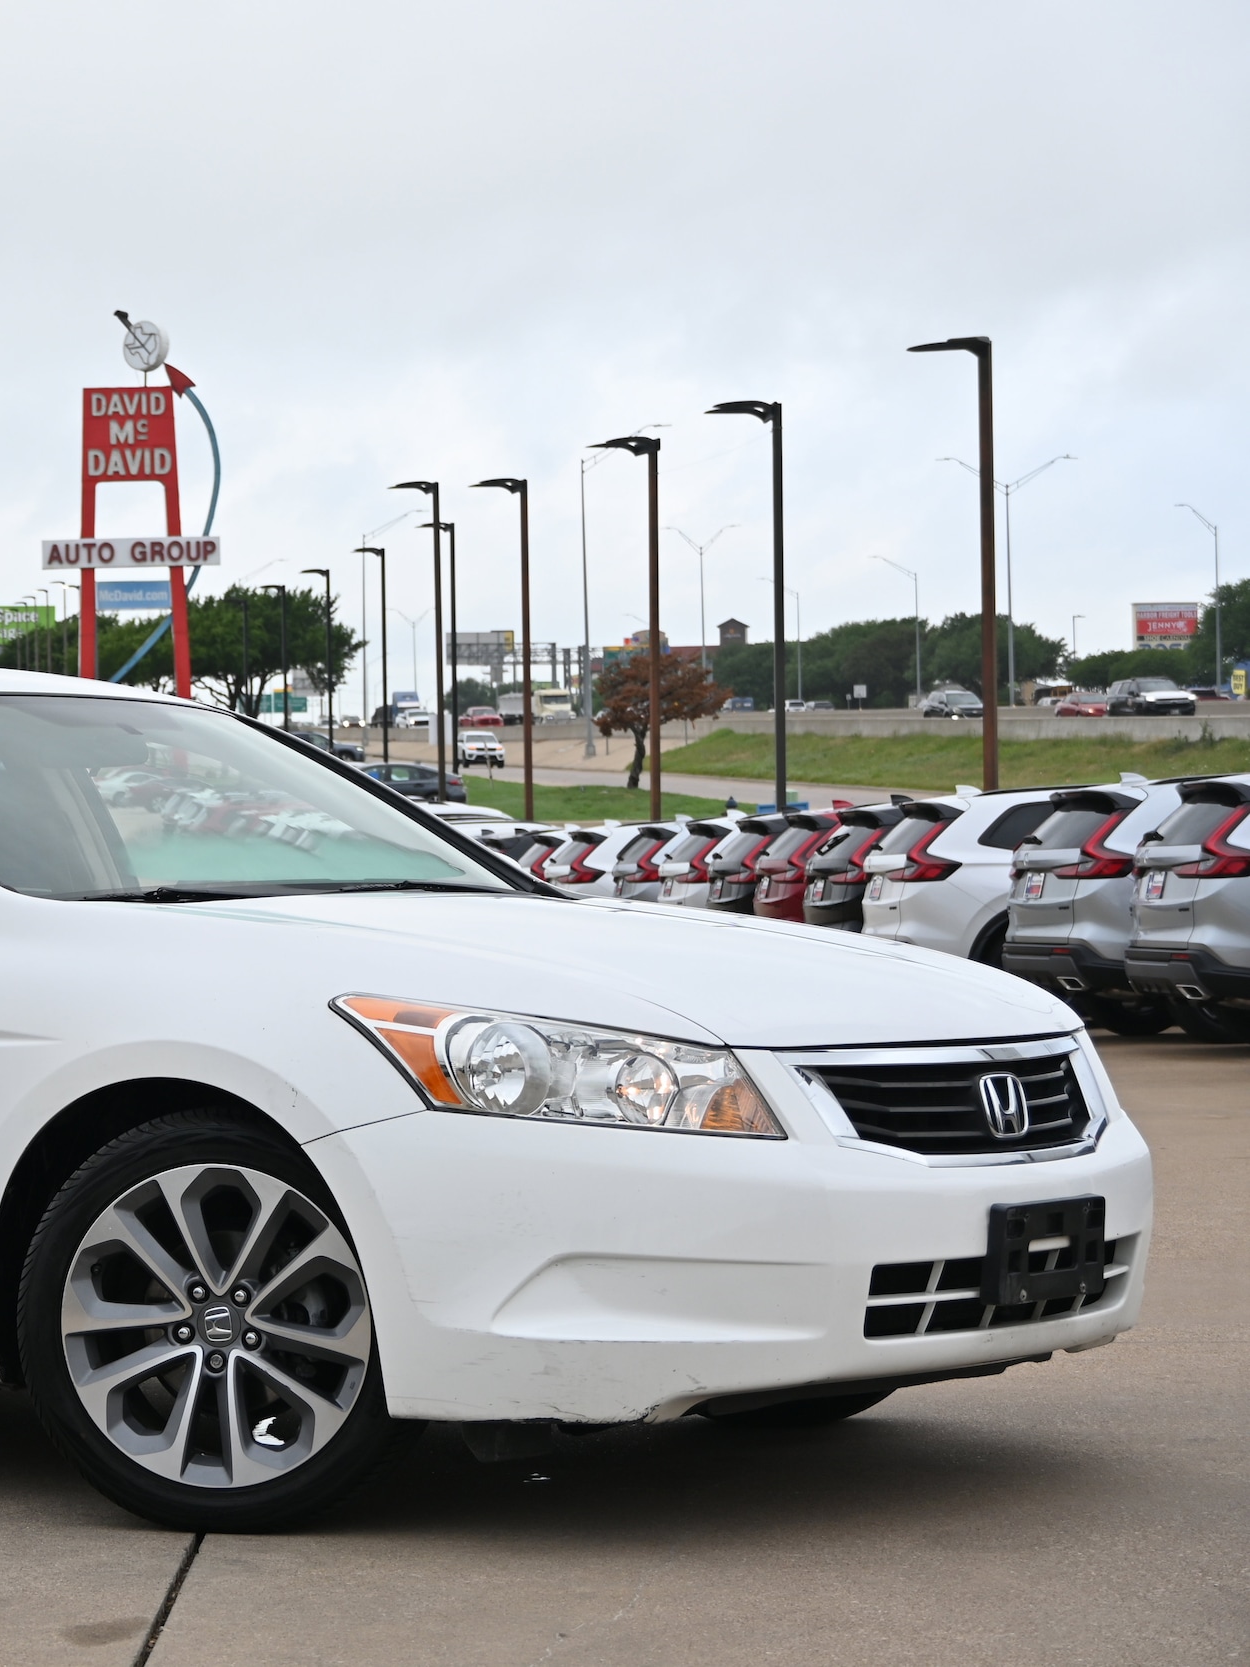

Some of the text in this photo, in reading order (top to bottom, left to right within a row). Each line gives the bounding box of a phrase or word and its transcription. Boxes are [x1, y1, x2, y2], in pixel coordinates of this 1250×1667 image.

[91, 391, 166, 417] DAVID
[87, 447, 172, 477] DAVID
[47, 540, 217, 565] AUTO GROUP
[99, 590, 168, 602] McDavid.com
